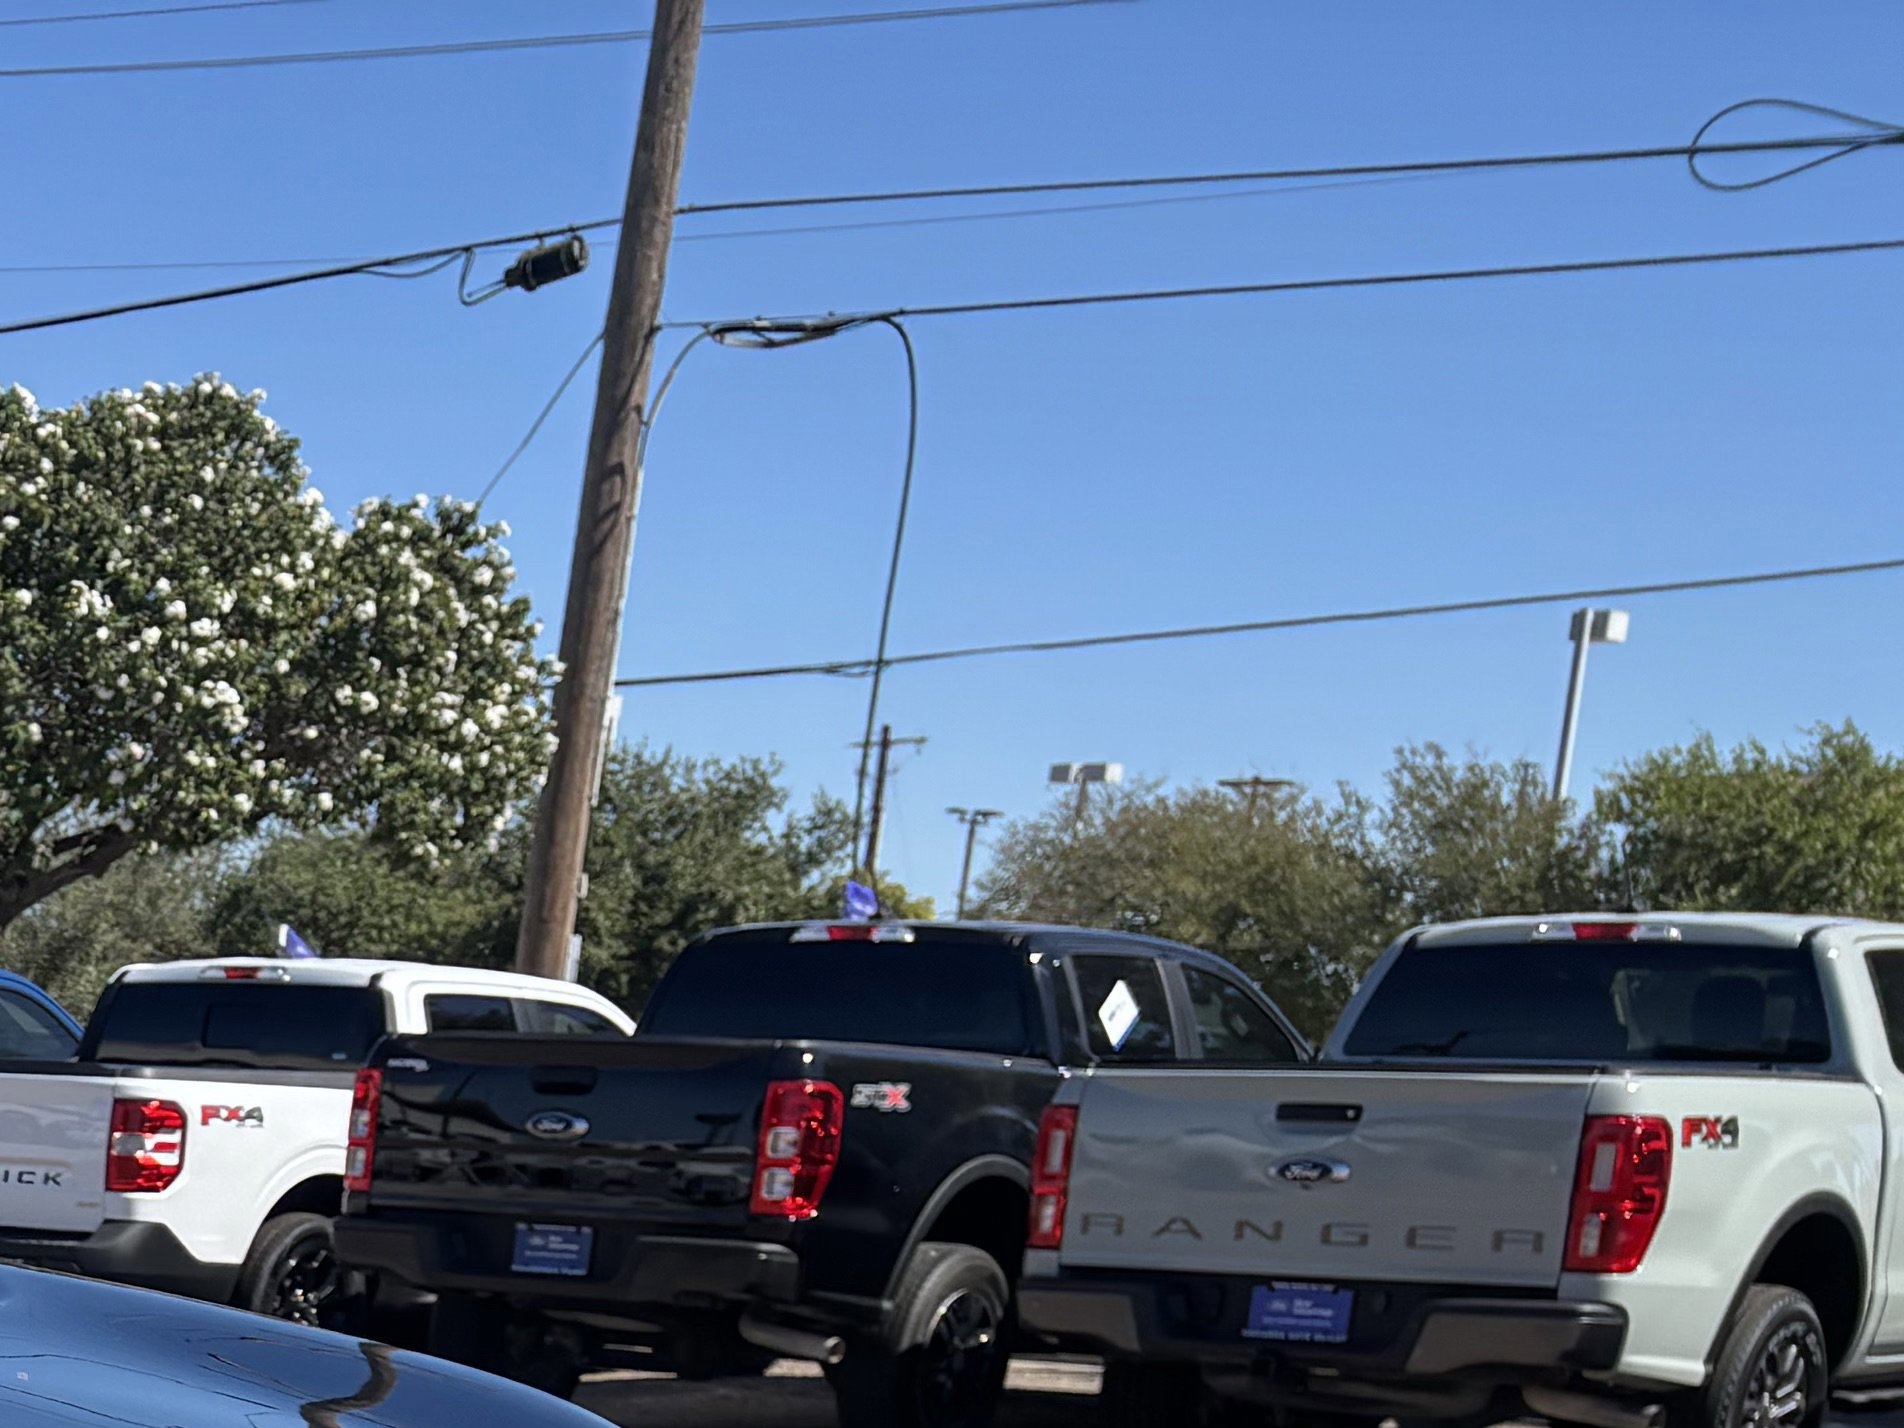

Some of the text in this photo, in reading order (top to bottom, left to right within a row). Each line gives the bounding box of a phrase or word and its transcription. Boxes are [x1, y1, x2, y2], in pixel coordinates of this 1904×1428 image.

[200, 1104, 264, 1128] FX4
[1681, 1115, 1739, 1150] FX4
[1080, 1211, 1544, 1254] RANGER
